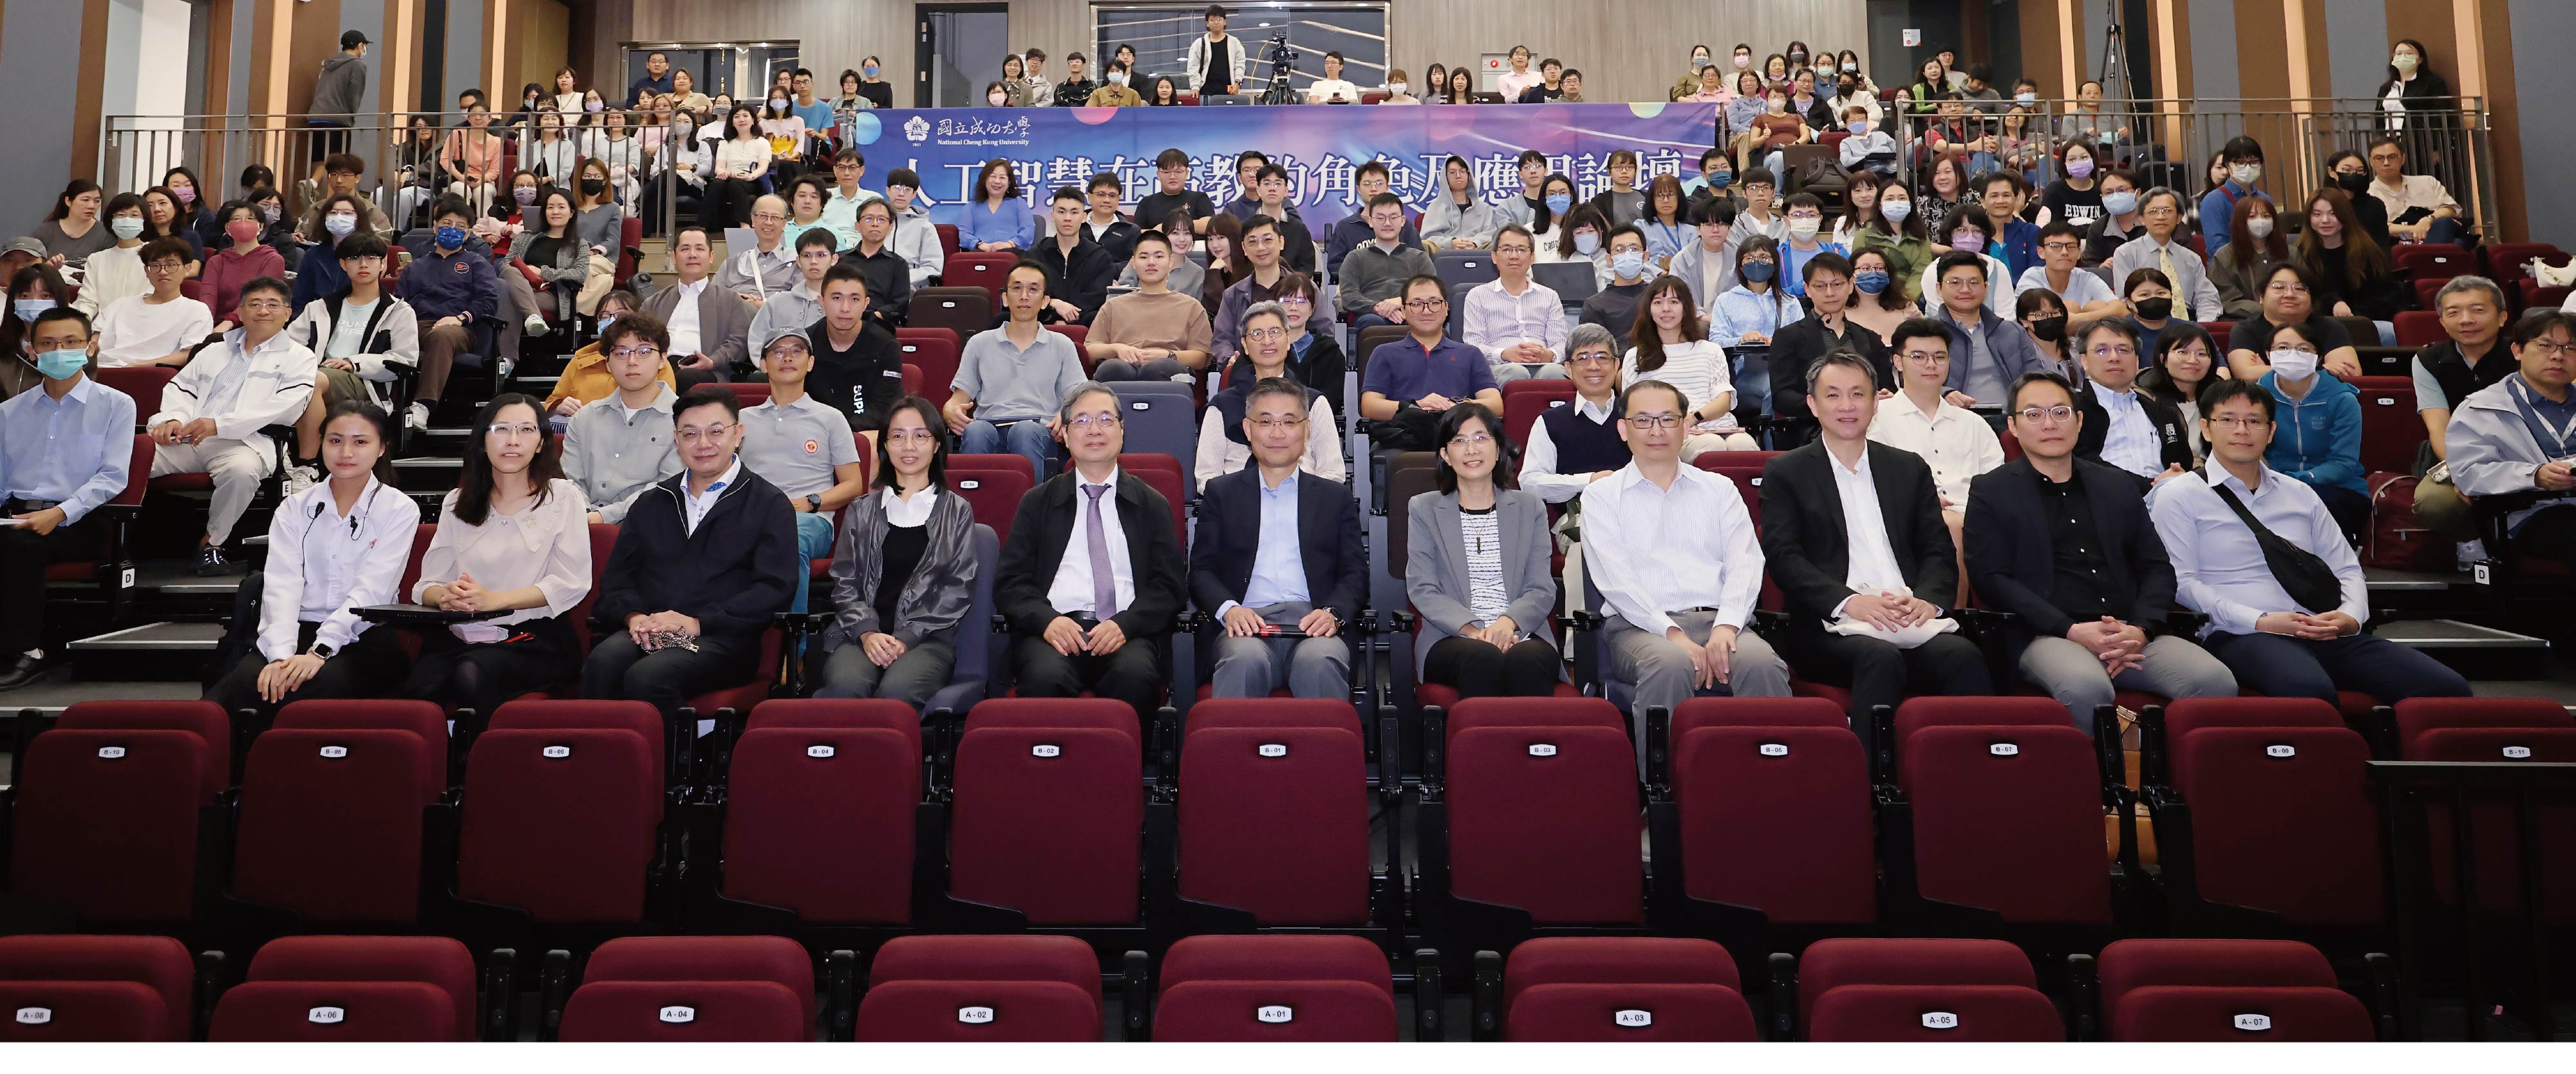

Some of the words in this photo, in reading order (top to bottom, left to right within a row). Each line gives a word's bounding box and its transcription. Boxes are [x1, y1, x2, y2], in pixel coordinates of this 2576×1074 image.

[2065, 203, 2101, 218] EDWIN
[285, 484, 289, 493] E
[126, 573, 131, 583] D
[2479, 569, 2485, 579] D
